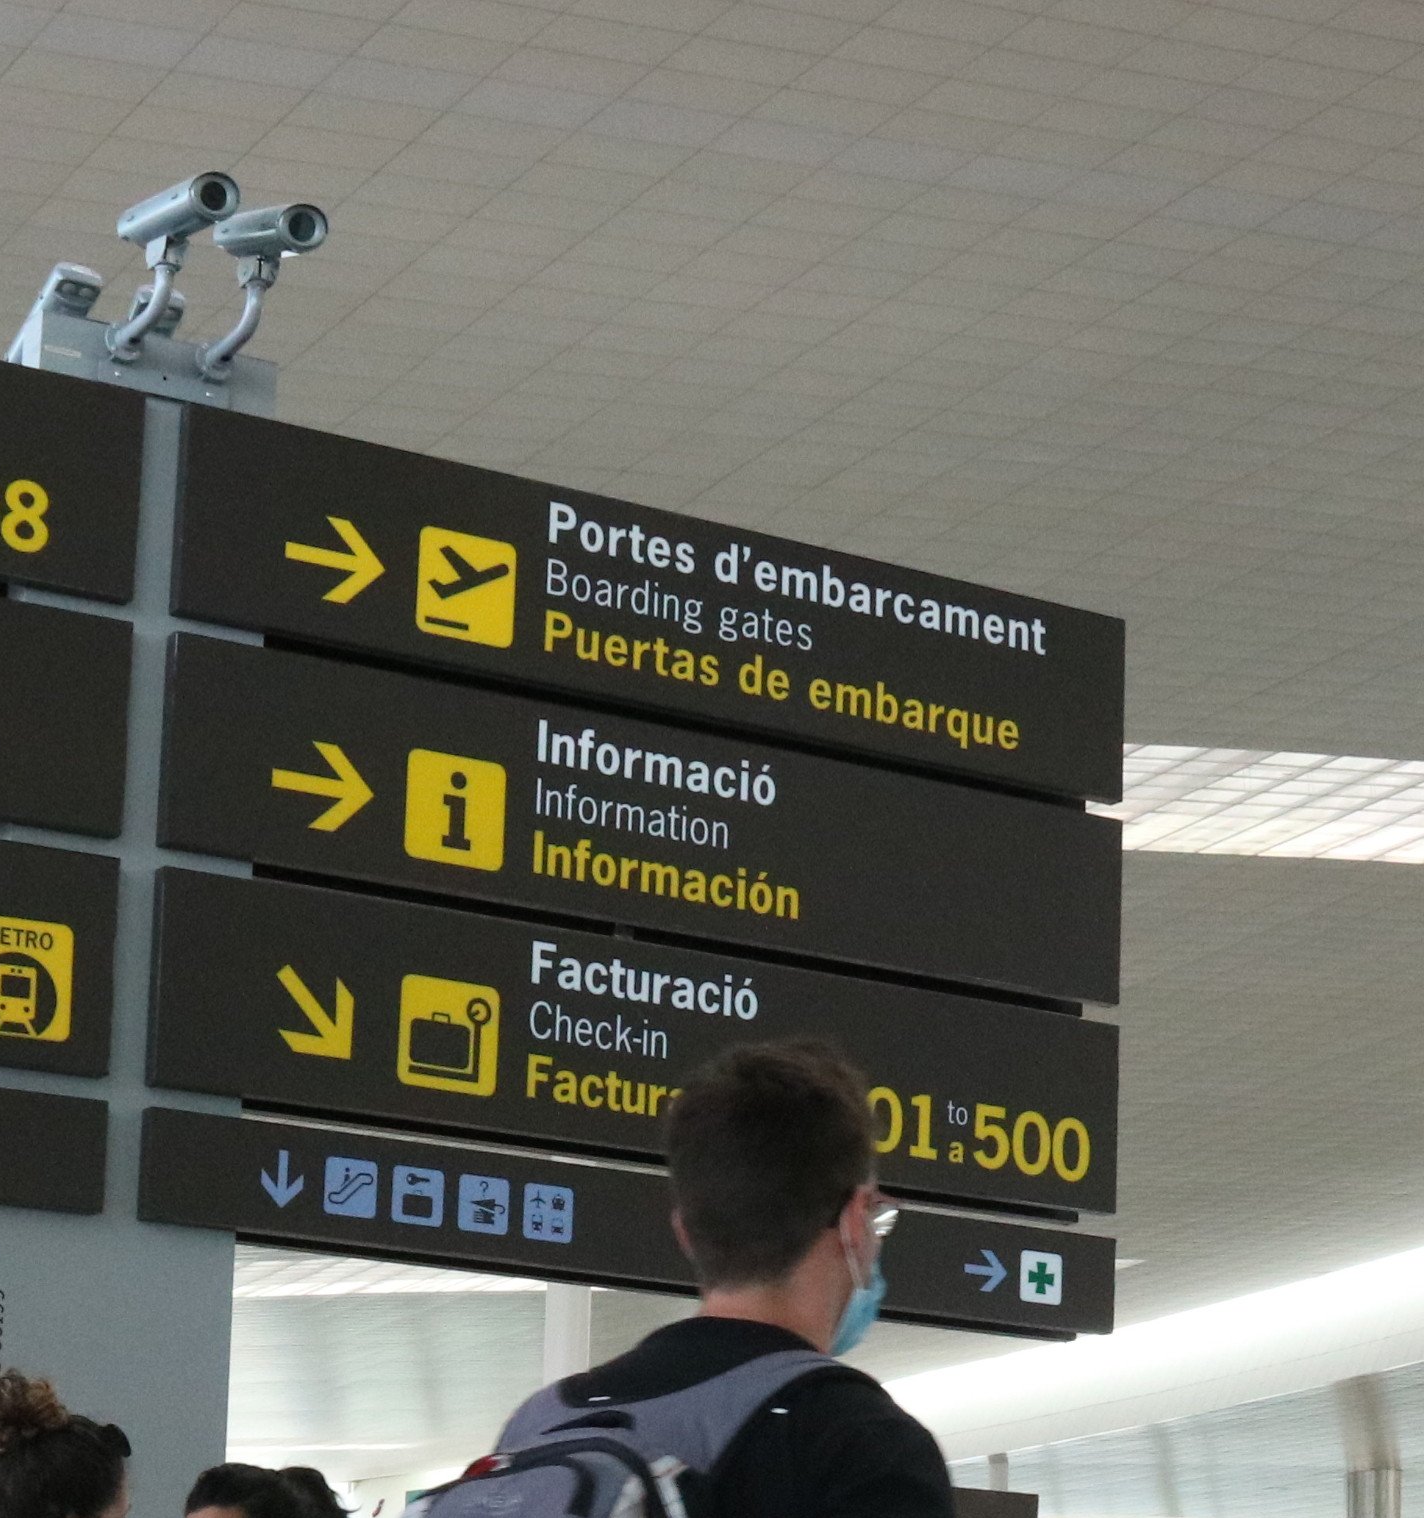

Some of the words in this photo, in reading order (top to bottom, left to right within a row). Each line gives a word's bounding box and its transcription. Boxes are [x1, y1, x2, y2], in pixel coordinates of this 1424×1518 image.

[545, 559, 703, 635] Boarding
[717, 601, 814, 653] gates
[547, 501, 696, 574] Portes
[715, 542, 1046, 655] d'embarcament
[543, 610, 719, 687] Puertas
[738, 654, 791, 702] de
[809, 680, 1021, 752] embarque
[535, 720, 778, 807] Informació
[534, 778, 731, 851] Information
[531, 832, 801, 920] Información
[529, 941, 760, 1021] Facturació
[527, 1000, 669, 1061] Check-in
[525, 1055, 680, 1118] Factur
[867, 1086, 938, 1161] 01
[946, 1099, 969, 1127] to
[971, 1105, 1092, 1182] 500
[948, 1140, 965, 1165] a
